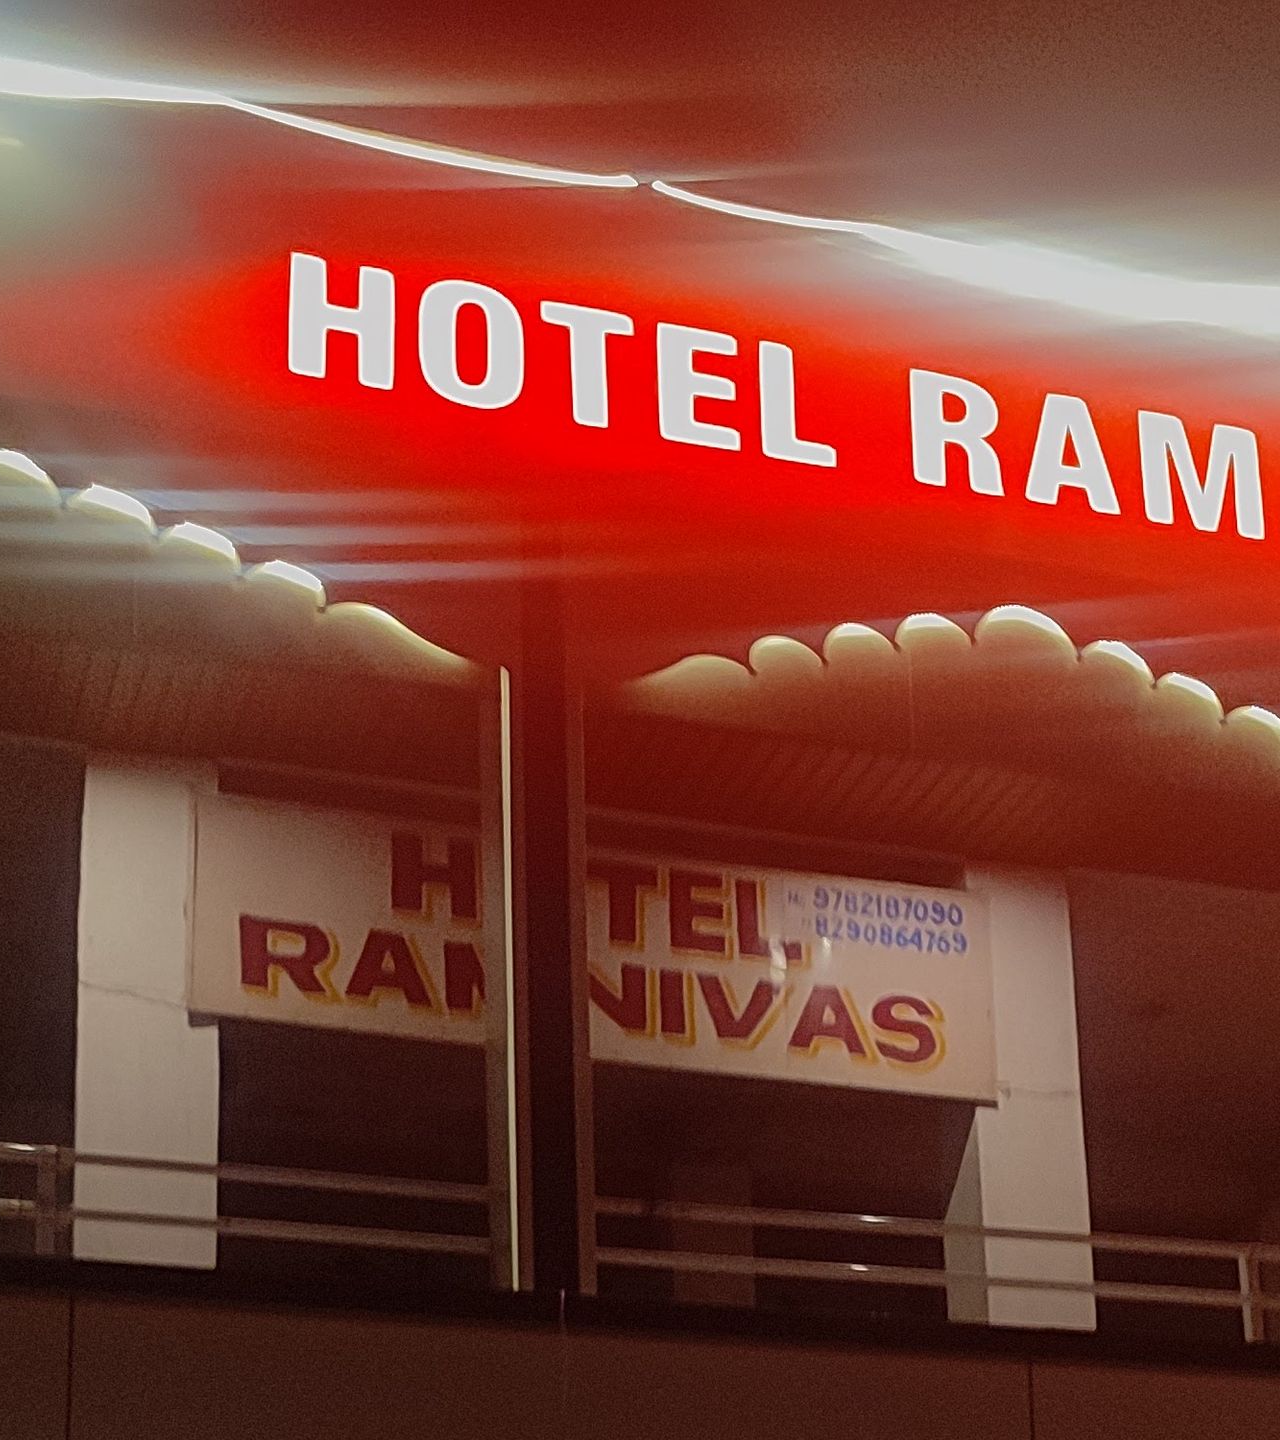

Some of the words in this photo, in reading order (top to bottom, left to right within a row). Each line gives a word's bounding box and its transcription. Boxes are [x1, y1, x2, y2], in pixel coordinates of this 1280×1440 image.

[287, 251, 837, 467] HOTEL
[908, 367, 1266, 541] RAM
[391, 832, 808, 966] HTEL
[813, 887, 964, 927] 9782187090
[816, 914, 967, 955] 8290864769
